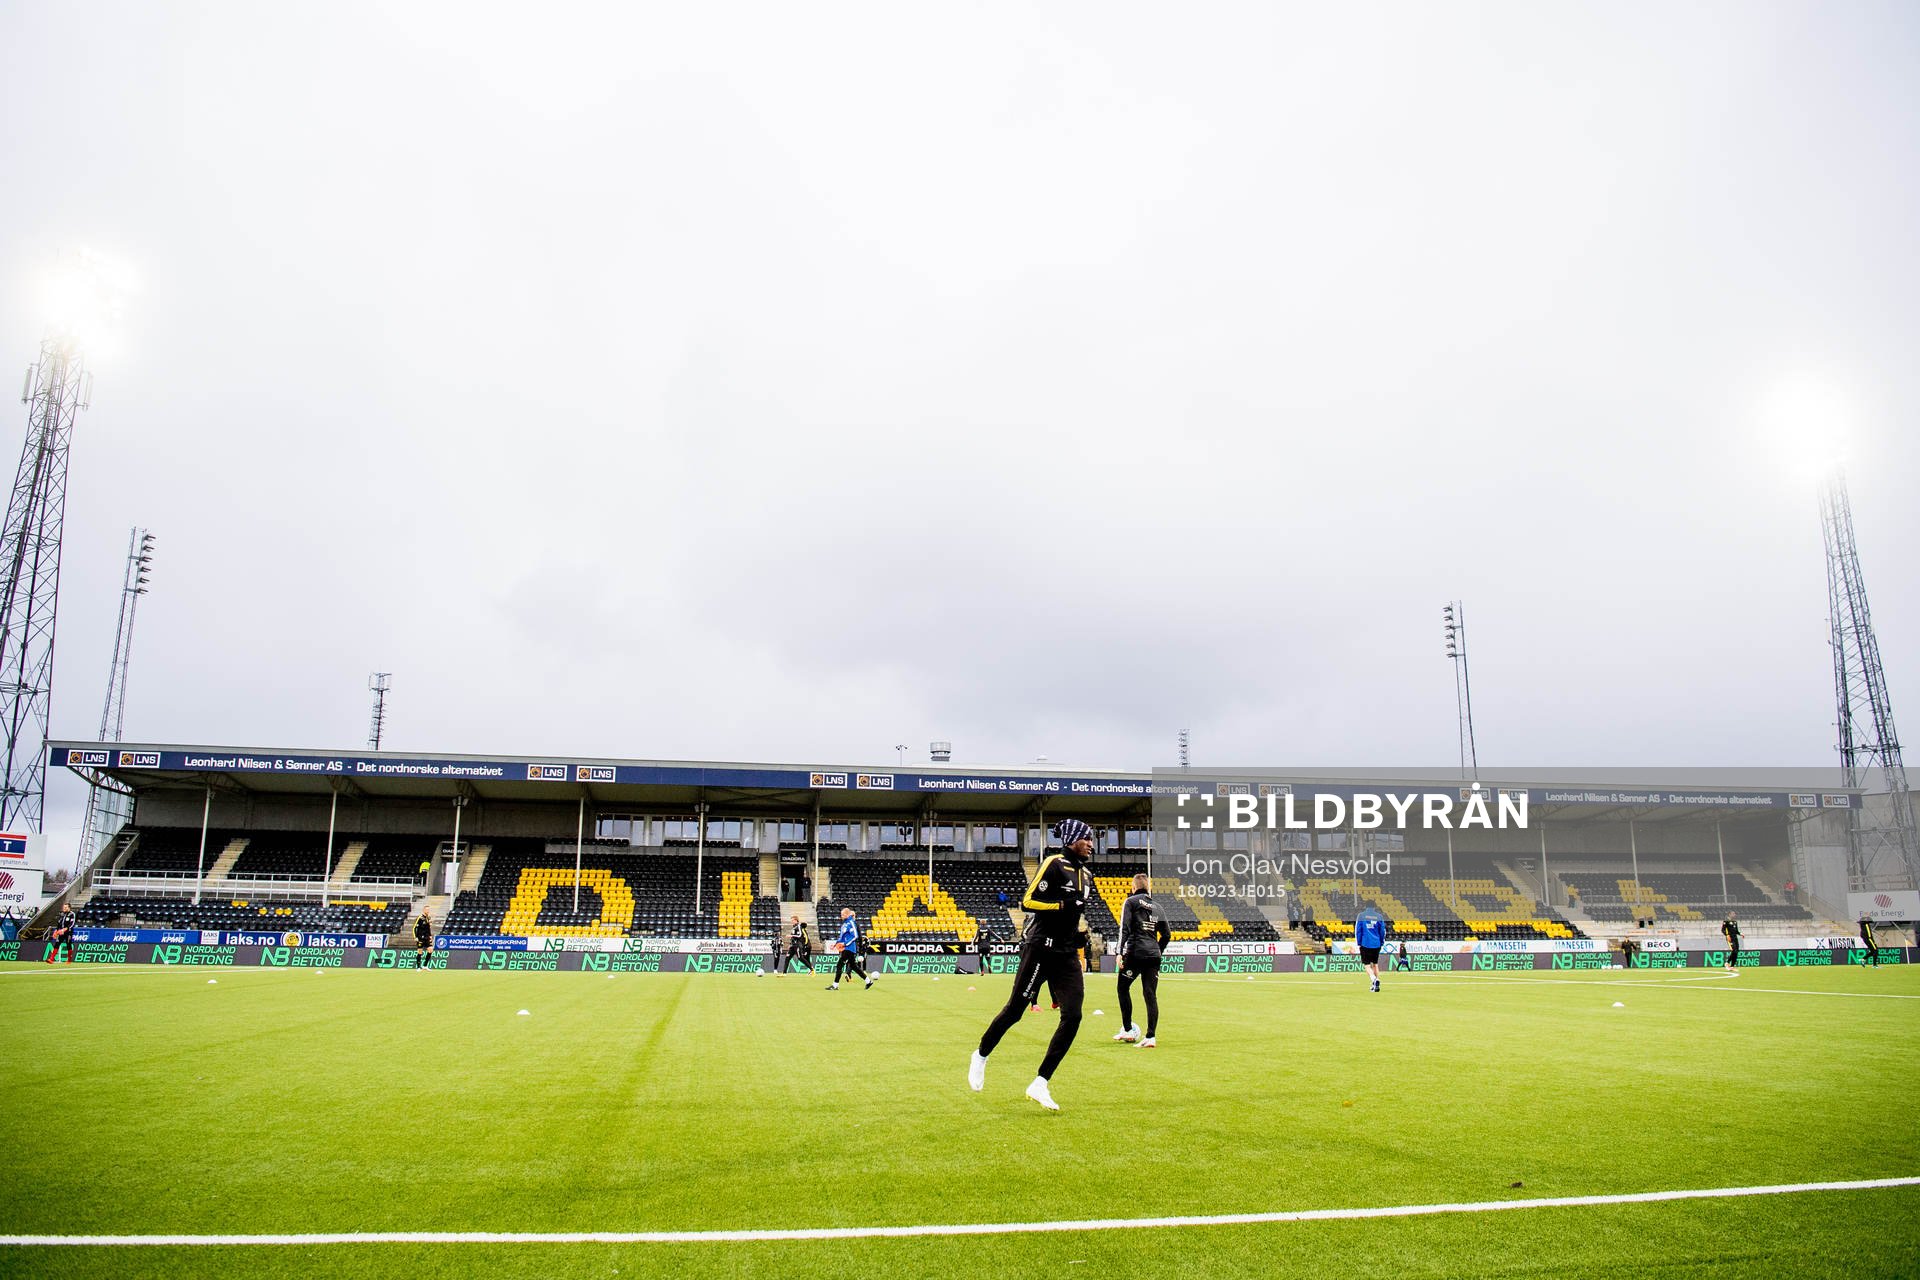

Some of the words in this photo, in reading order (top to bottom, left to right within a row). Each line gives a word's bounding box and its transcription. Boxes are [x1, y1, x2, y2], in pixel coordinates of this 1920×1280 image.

[185, 757, 235, 767] Leonhard
[238, 758, 272, 769] Nilsen
[274, 760, 283, 768] &
[286, 760, 324, 771] Sønner
[327, 762, 342, 770] AS
[357, 762, 376, 772] Det
[378, 762, 440, 773] nordnorske
[442, 765, 502, 775] alternativet
[545, 769, 562, 777] LNS
[593, 770, 611, 778] LNS
[873, 778, 890, 786] LNS
[919, 779, 964, 789] Leonhard
[967, 780, 996, 789] Nilsen
[999, 781, 1007, 790] &
[1009, 781, 1043, 791] Sønner
[1072, 783, 1089, 791] Det
[1091, 783, 1144, 793] nordnorske
[1146, 784, 1198, 794] alternativet
[1546, 792, 1582, 801] Leonhard
[1584, 793, 1609, 802] Nilsen
[1649, 794, 1660, 802] AS
[1669, 795, 1684, 803] Det
[1685, 796, 1728, 804] nordnorske
[1729, 796, 1772, 804] alternativet
[1881, 909, 1904, 917] Energi
[113, 934, 138, 942] KPMG
[161, 935, 186, 943] KPMG
[226, 933, 275, 945] laks.no
[308, 935, 357, 947] laks.no
[78, 943, 128, 951] NORDLAND
[545, 938, 564, 951] NB
[623, 939, 642, 952] NB
[886, 944, 944, 953] DIADORA
[966, 945, 1020, 953] DIDORA
[152, 945, 181, 963] NB
[260, 947, 289, 965] NB
[294, 948, 344, 956] NORDLAND
[400, 950, 449, 958] NORDAND
[75, 953, 126, 962] BETONG
[182, 955, 233, 964] BETONG
[291, 957, 342, 966] BETONG
[367, 949, 396, 968] NB
[478, 951, 506, 969] NB
[581, 953, 610, 970] NB
[1472, 954, 1494, 970] NB
[1552, 954, 1574, 969] NB
[1631, 952, 1650, 968] NB
[1704, 952, 1724, 967] NB
[1778, 950, 1797, 966] NB
[1868, 956, 1900, 964] BTONG
[398, 959, 447, 968] BEONG
[508, 961, 557, 970] BETONG
[612, 962, 659, 971] BETONG
[685, 955, 713, 972] NB
[714, 964, 761, 972] BETONG
[883, 956, 909, 973] NB
[1206, 956, 1229, 972] NB
[1232, 964, 1272, 972] BETONG
[1304, 956, 1327, 971] NB
[1496, 961, 1534, 969] BETONG
[1652, 960, 1686, 968] BETONG
[911, 964, 956, 973] BETONG
